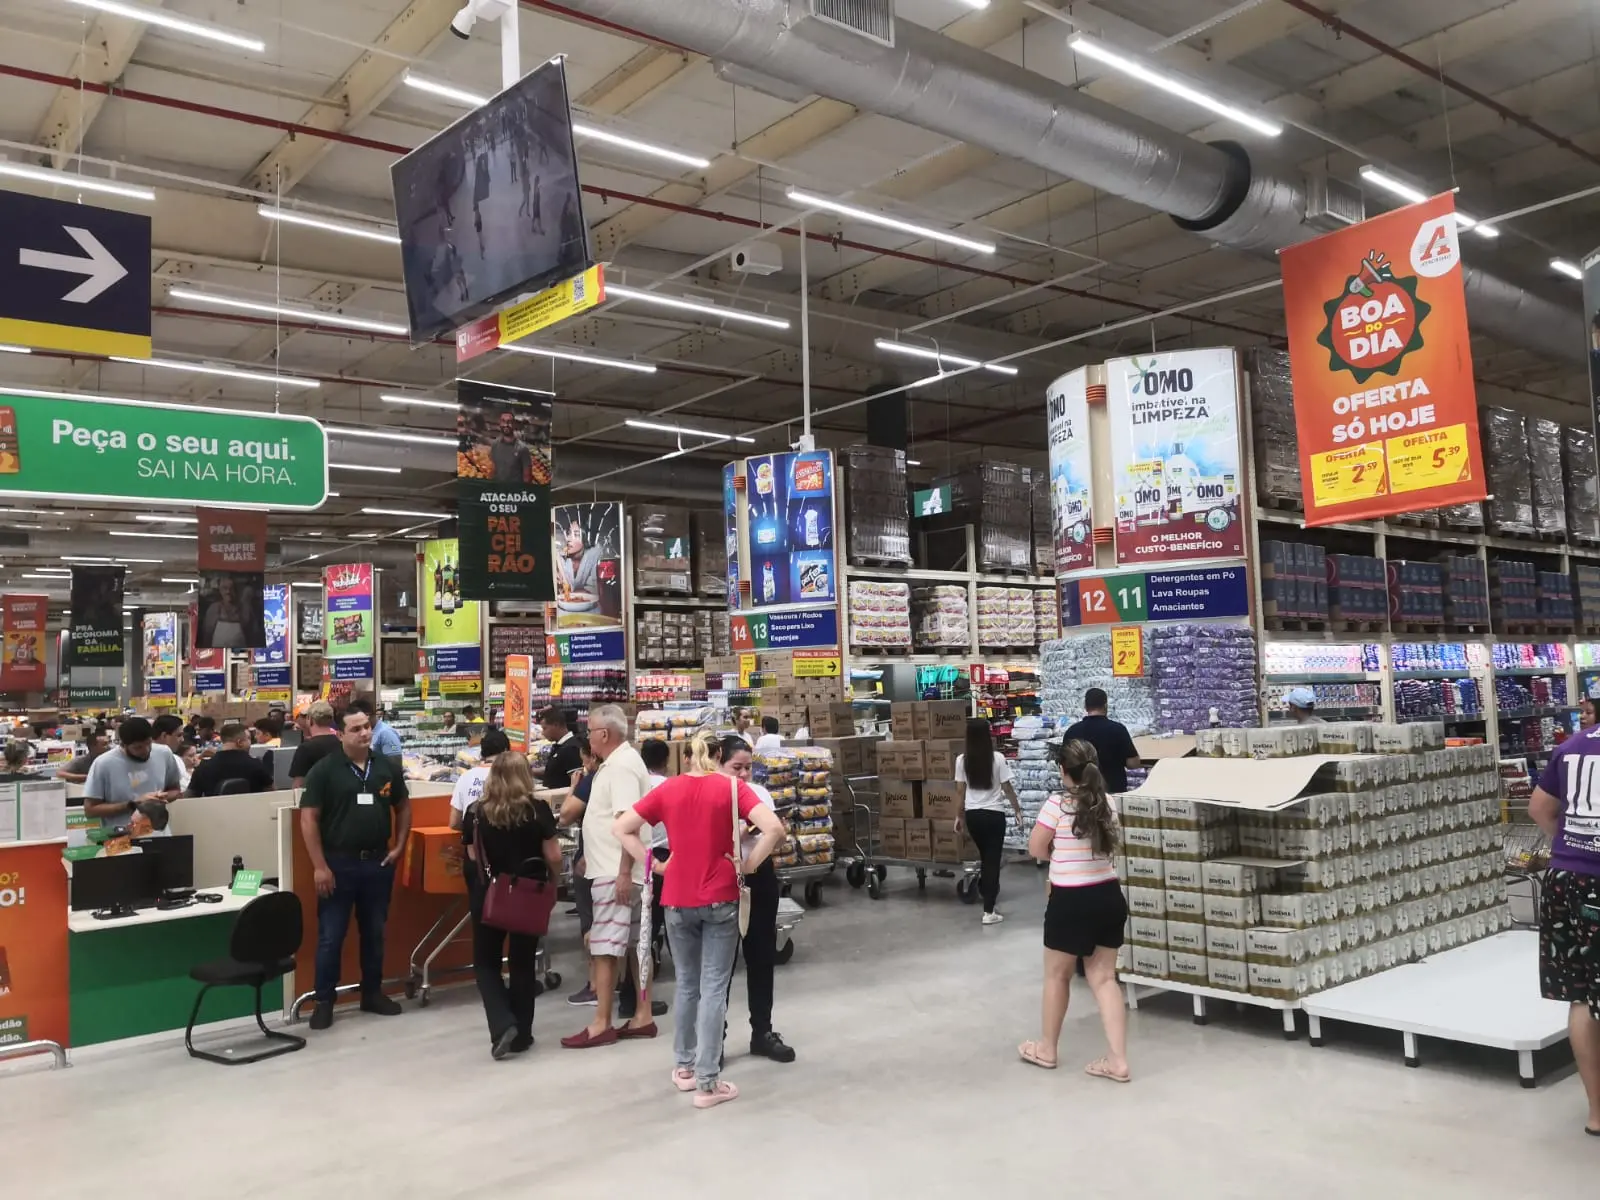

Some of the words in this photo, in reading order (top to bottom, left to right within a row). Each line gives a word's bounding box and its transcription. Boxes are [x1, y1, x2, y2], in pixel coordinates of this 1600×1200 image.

[1340, 293, 1406, 330] BOA
[1365, 320, 1384, 333] DO
[1349, 327, 1403, 360] DIA
[1144, 367, 1194, 396] OMO
[1191, 396, 1206, 406] na
[1333, 377, 1430, 415] OFERTA
[1132, 405, 1210, 425] LIMPEZA
[1332, 415, 1365, 443] SÓ
[1371, 404, 1436, 436] HOJE
[52, 419, 127, 454] Peça
[137, 432, 157, 451] o
[165, 434, 219, 456] seu
[228, 437, 296, 463] aqui.
[1403, 431, 1448, 448] OFERTA
[137, 458, 176, 480] SAI
[184, 461, 219, 482] NA
[226, 464, 297, 486] HORA.
[480, 491, 537, 503] ATACADÃO
[1135, 489, 1161, 504] OMO
[1197, 484, 1224, 498] OMO
[489, 505, 498, 513] O
[499, 505, 518, 513] SEU
[1119, 510, 1134, 519] OMO
[209, 525, 234, 535] PRA
[487, 515, 521, 533] PAR
[1151, 535, 1159, 543] O
[1160, 532, 1202, 542] MELHOR
[209, 543, 256, 553] SEMPRE
[1135, 541, 1223, 554] CUSTO-BENEFÍCIO
[1150, 573, 1205, 584] Detergentes
[1223, 571, 1236, 580] Pó
[1082, 589, 1107, 612] 12
[1117, 586, 1143, 610] 11
[1151, 589, 1174, 598] Lava
[1175, 588, 1210, 598] Roupas
[1152, 602, 1205, 612] Amaciantes
[71, 630, 119, 639] ECONOMIA
[733, 626, 748, 641] 14
[752, 623, 767, 640] 13
[546, 644, 556, 657] 16
[559, 642, 569, 656] 15
[70, 689, 111, 699] Hortifruti
